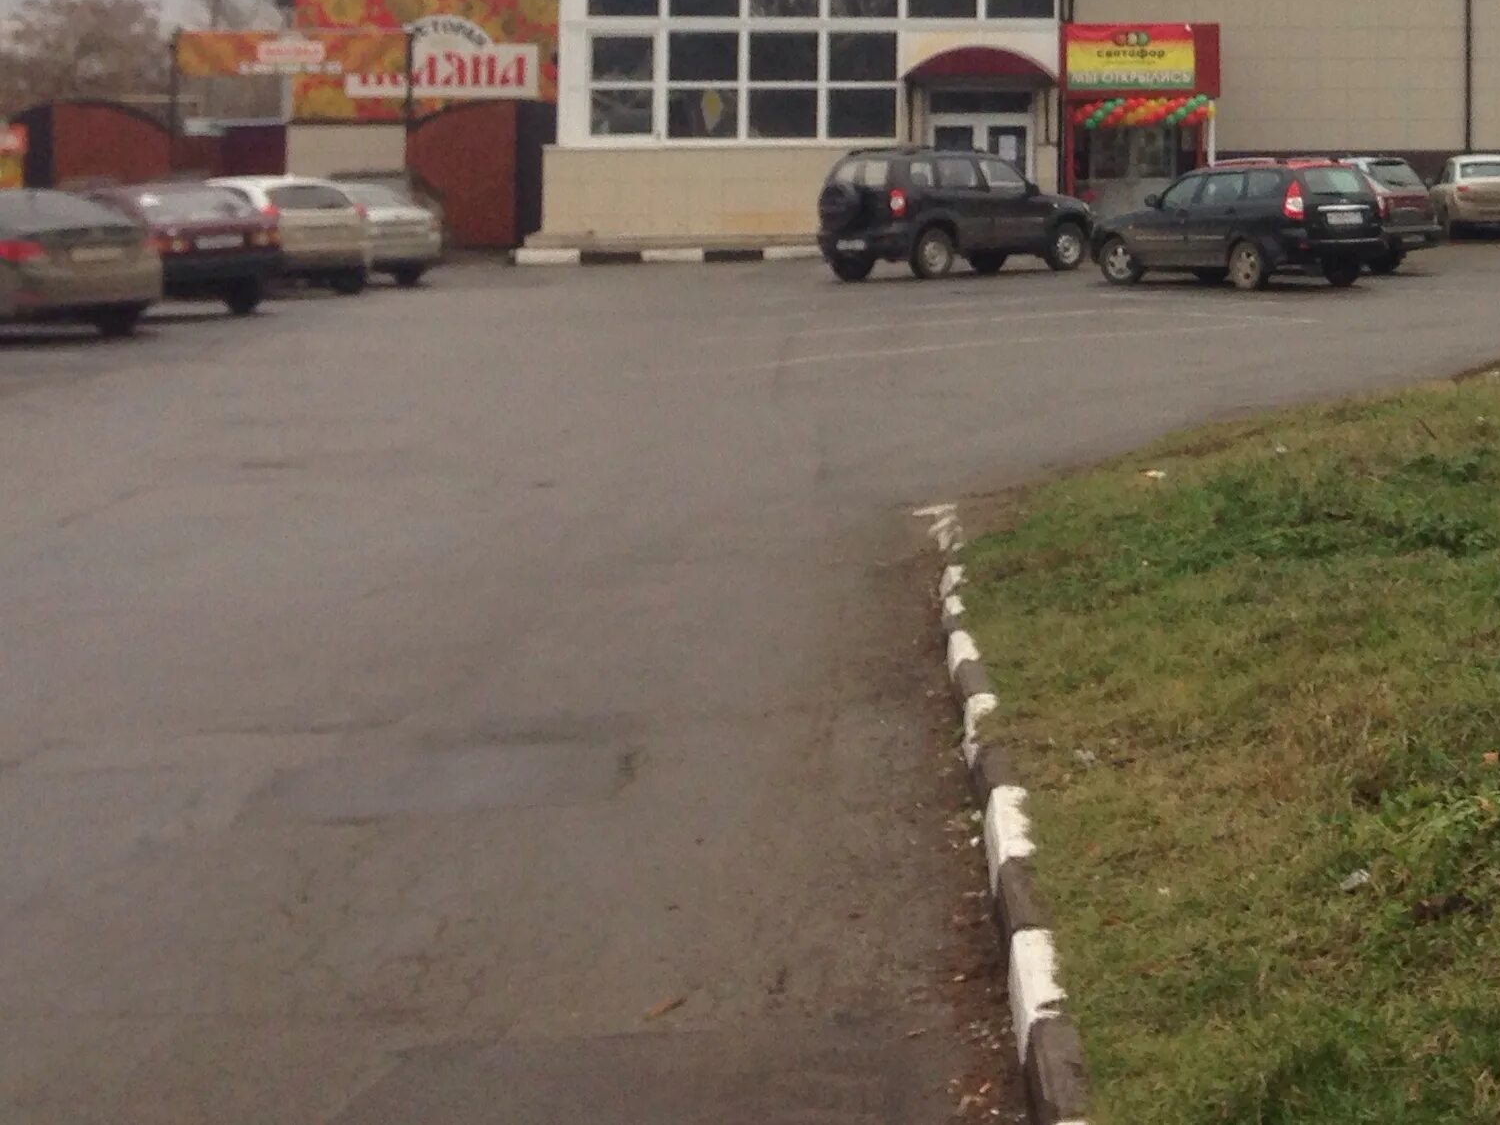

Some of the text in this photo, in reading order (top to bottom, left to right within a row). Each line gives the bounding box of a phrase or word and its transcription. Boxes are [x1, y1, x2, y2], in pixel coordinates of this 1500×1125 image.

[1096, 48, 1166, 59] светофор
[1072, 72, 1192, 83] МЫ ОТКРЫЛИСЬ
